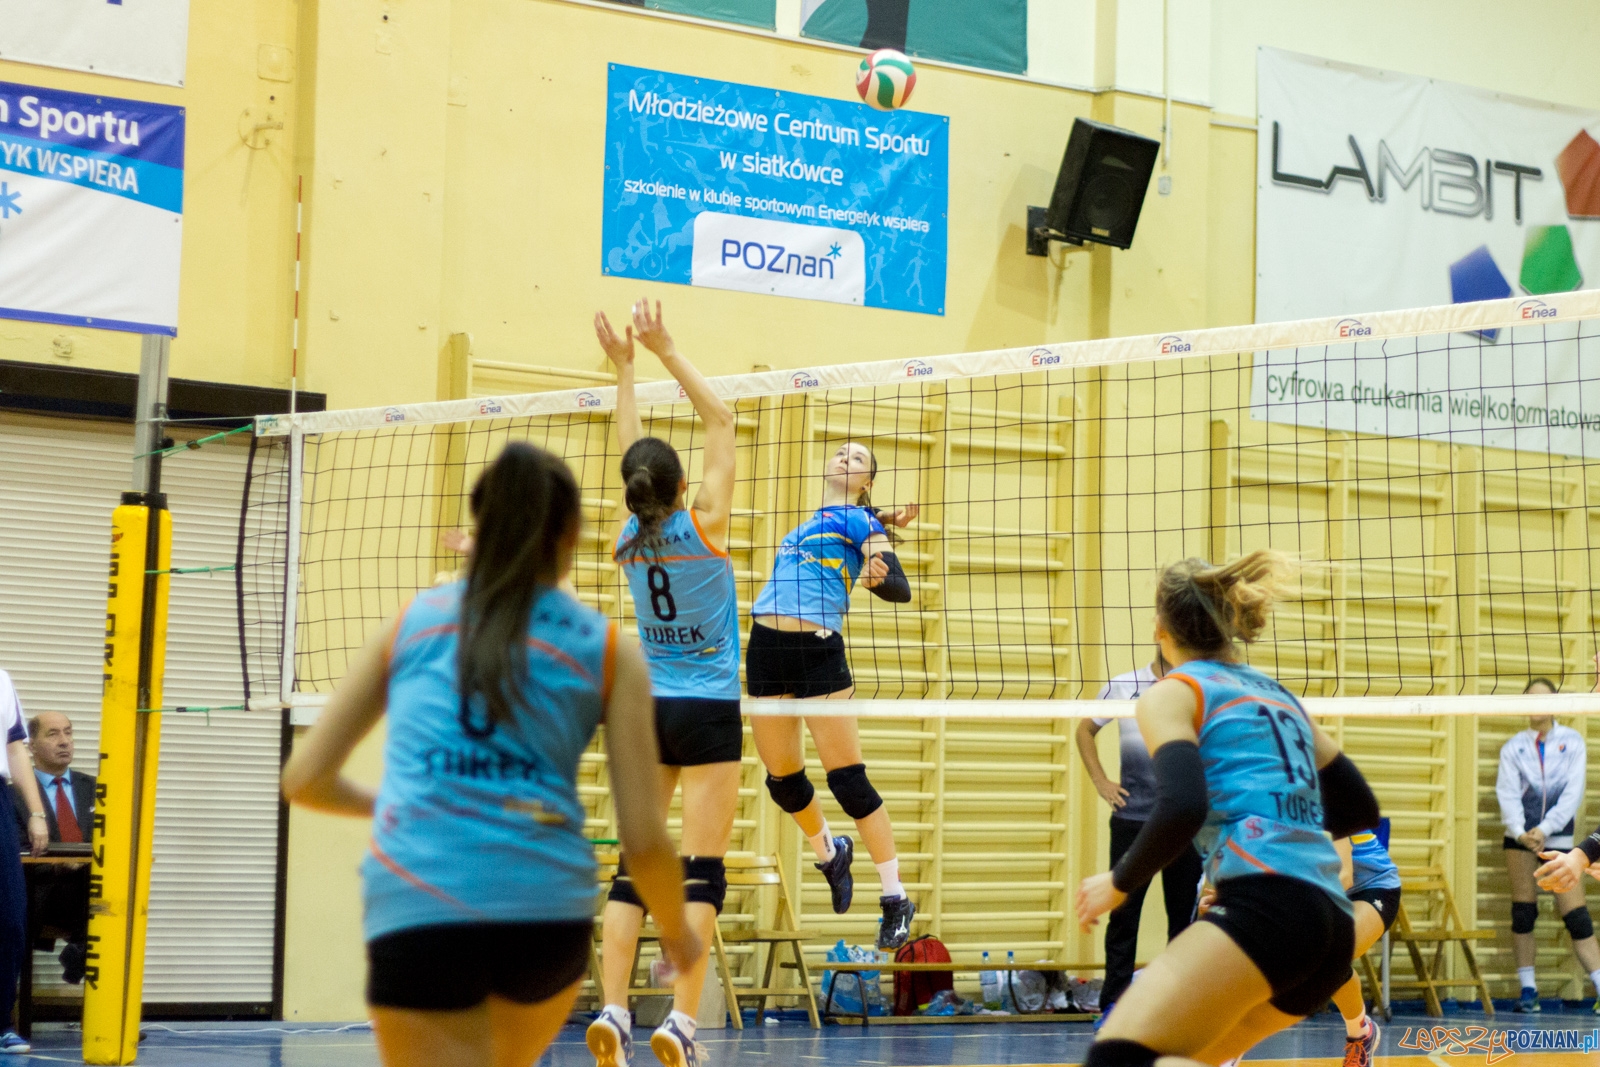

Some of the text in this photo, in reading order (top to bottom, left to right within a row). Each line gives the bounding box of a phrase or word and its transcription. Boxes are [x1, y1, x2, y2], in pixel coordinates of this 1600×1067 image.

[19, 95, 140, 147] Sportu
[628, 89, 930, 157] Młodzieżowe Centrum Sportu
[0, 141, 140, 195] YK WSPIERA
[719, 151, 844, 187] w siatkówce
[1272, 121, 1543, 225] LAMBIT
[624, 179, 930, 234] szkolenie w klubie sportowym Energetyk wspiera
[1521, 305, 1557, 319] Enea
[1340, 324, 1371, 337] Enea
[1032, 353, 1060, 366] Enea
[1161, 341, 1191, 354] Enea
[794, 376, 819, 388] Enea
[907, 364, 933, 376] Enea
[480, 404, 501, 415] Enea
[579, 397, 601, 408] Enea
[1267, 371, 1600, 433] cyfrowa drukarnia wielkoformatowa
[385, 412, 405, 422] Enea
[647, 565, 677, 621] 8
[644, 623, 706, 645] TUREK
[1258, 704, 1316, 790] 13
[1268, 791, 1324, 826] TURE
